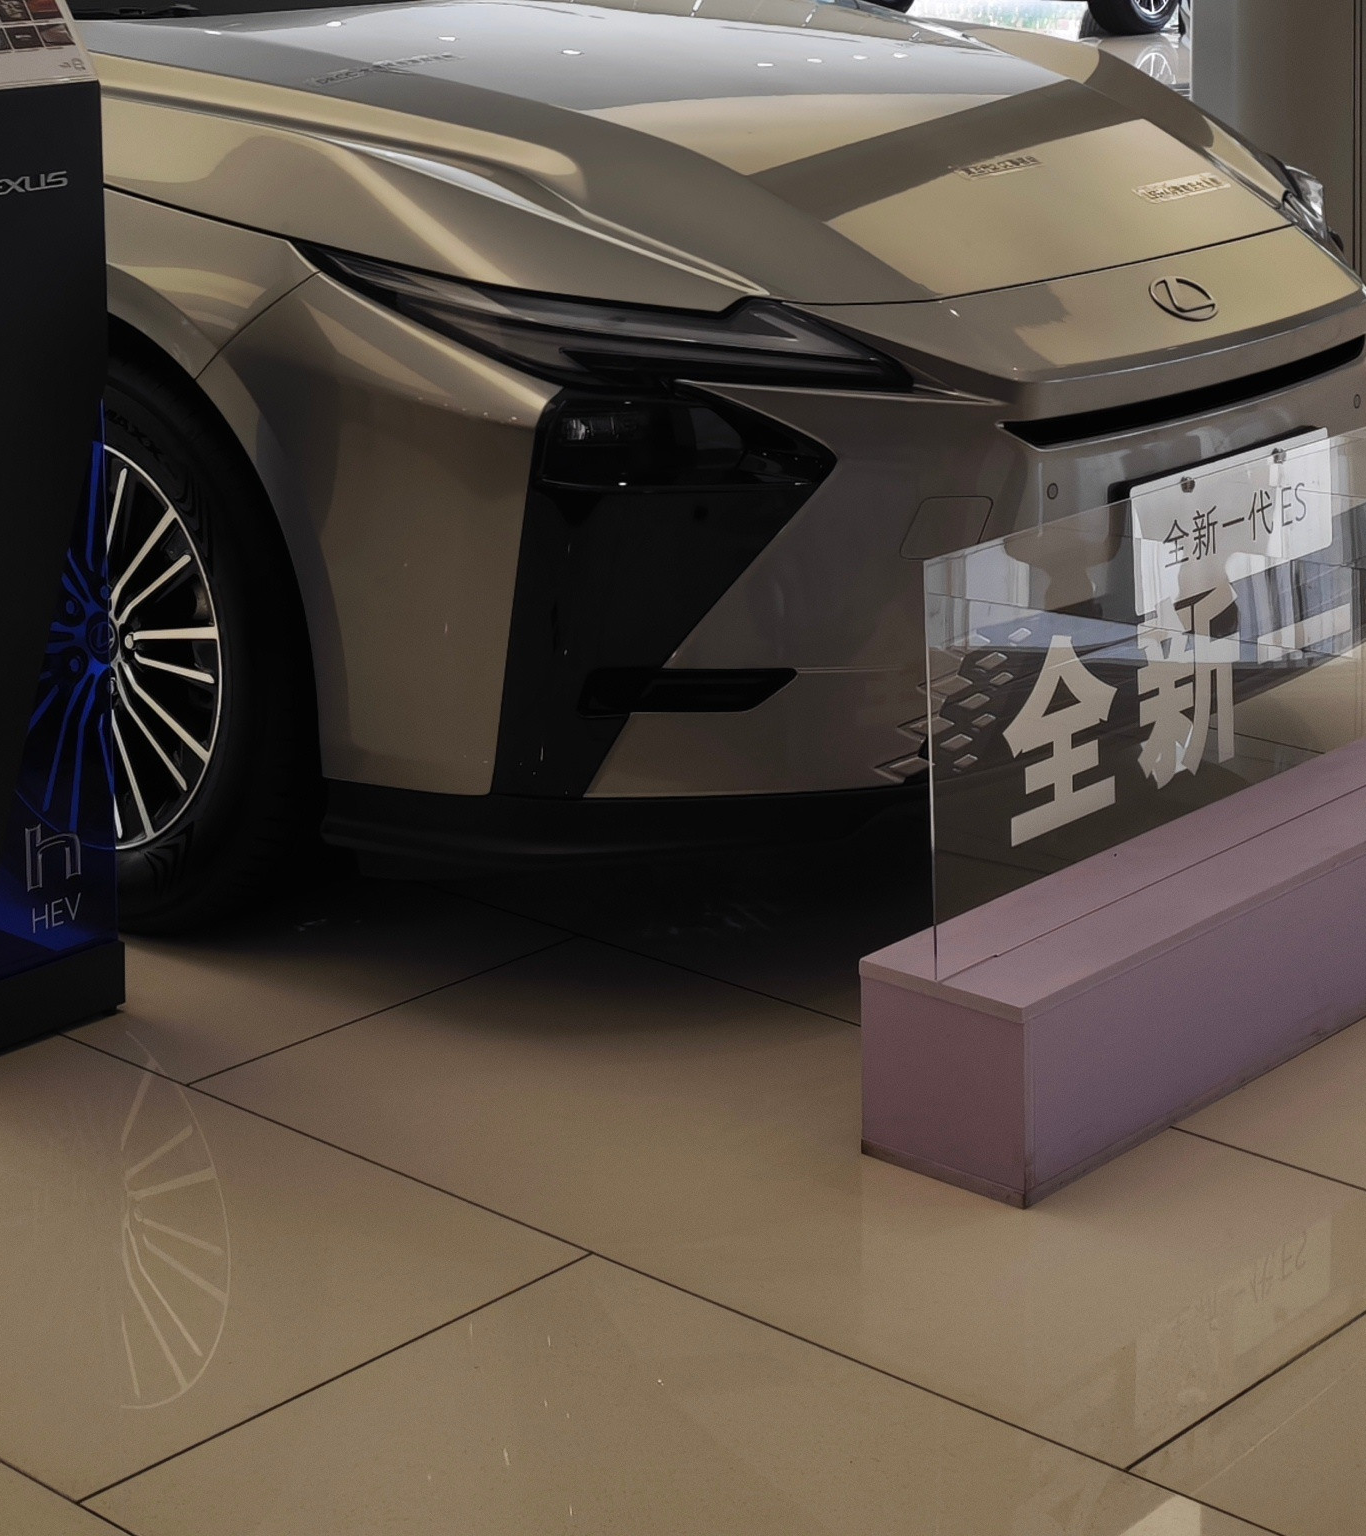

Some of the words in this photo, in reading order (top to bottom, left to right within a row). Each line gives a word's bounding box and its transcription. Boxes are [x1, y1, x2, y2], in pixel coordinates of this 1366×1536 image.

[1162, 480, 1308, 570] 全新一代ES
[31, 892, 82, 935] HEV
